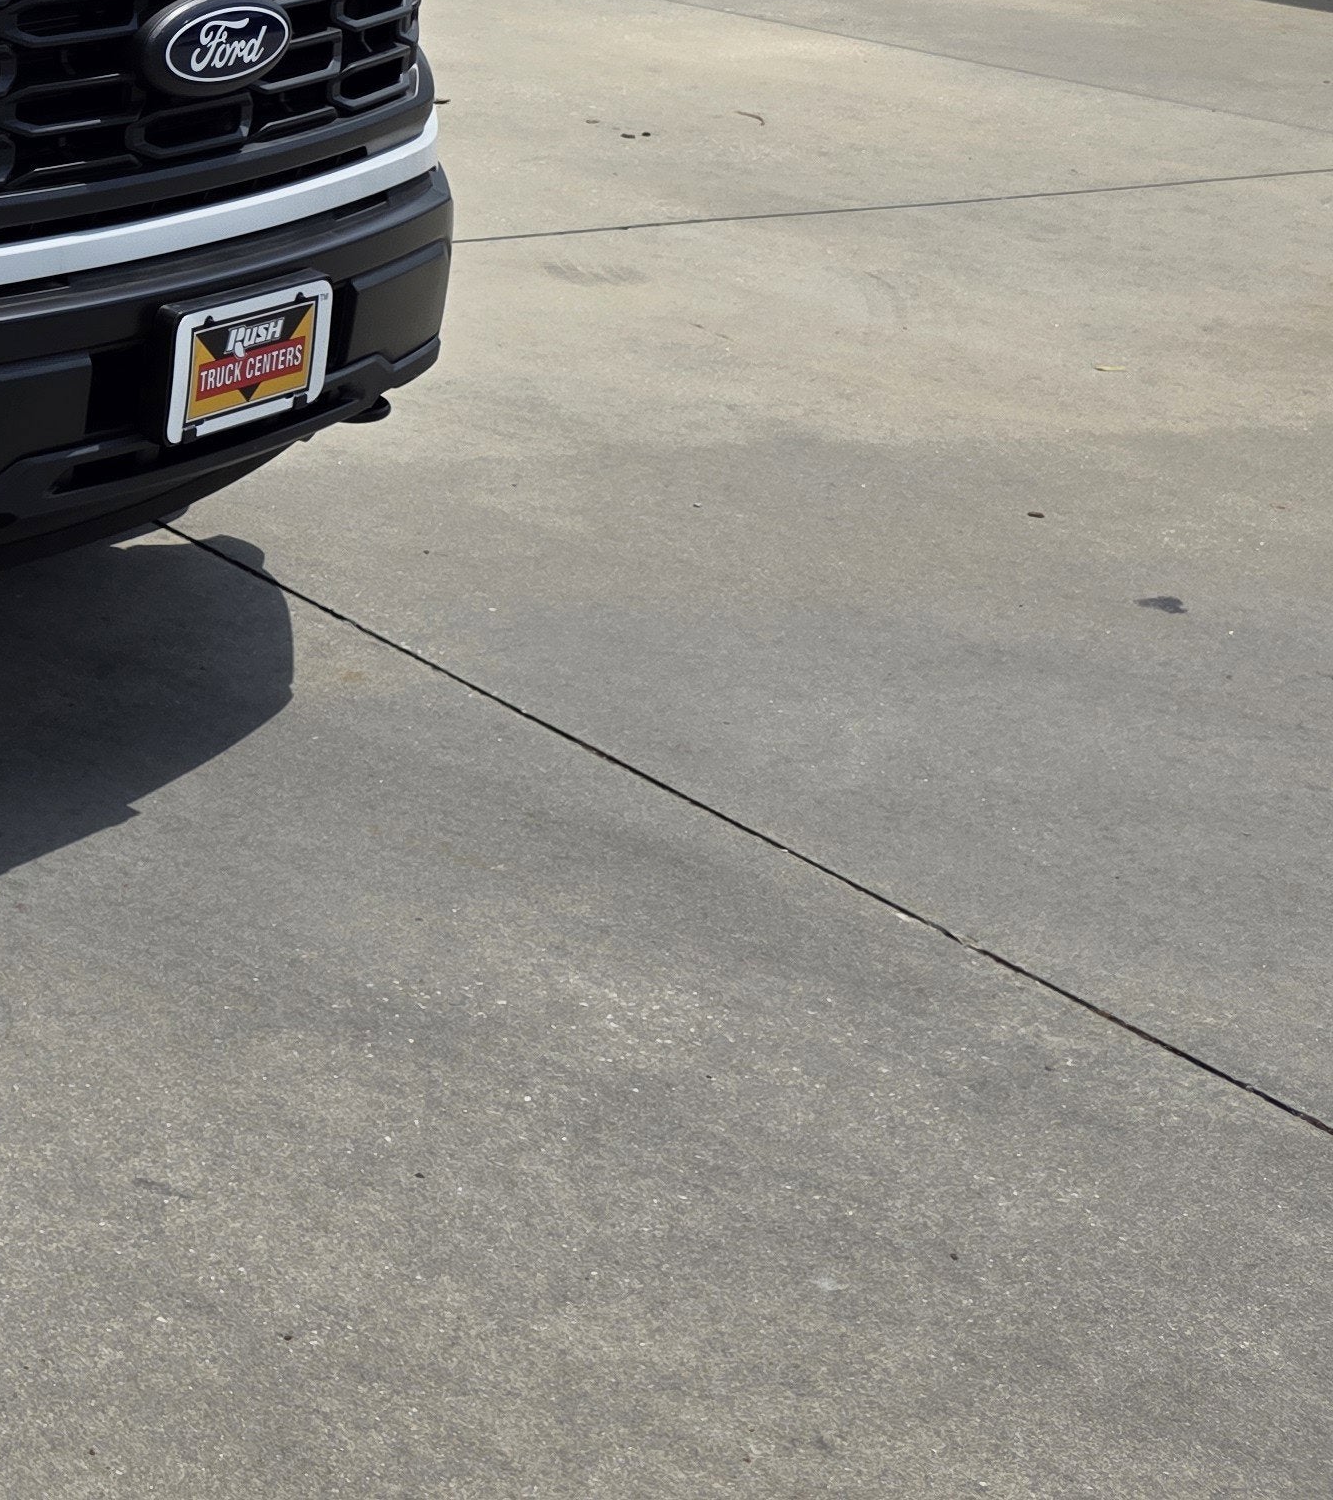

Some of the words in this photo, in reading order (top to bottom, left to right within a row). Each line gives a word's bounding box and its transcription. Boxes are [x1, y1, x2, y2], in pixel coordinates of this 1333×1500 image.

[190, 18, 268, 73] Ford
[200, 361, 243, 392] TRUCK
[246, 344, 303, 380] CENTERS
